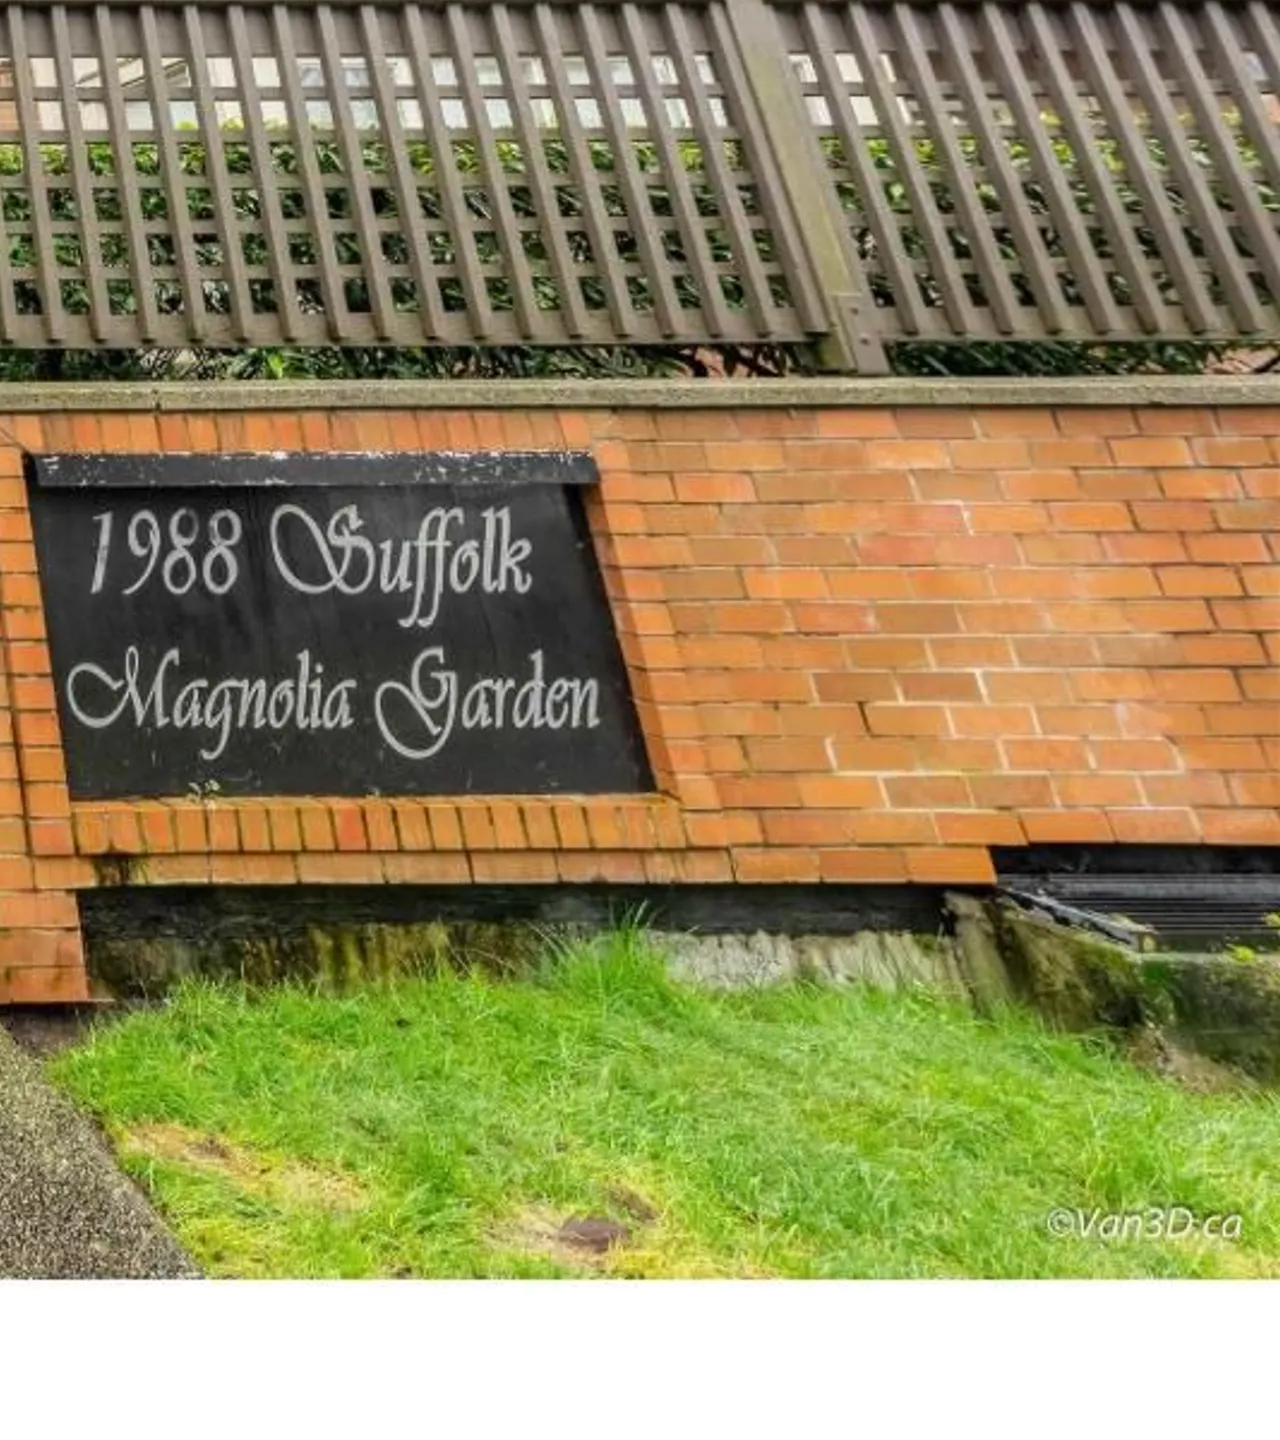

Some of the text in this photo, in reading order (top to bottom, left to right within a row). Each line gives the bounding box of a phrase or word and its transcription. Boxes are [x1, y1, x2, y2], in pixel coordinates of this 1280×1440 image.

[89, 503, 533, 628] 1988 Suffolk
[65, 645, 601, 760] Magnolia Garden
